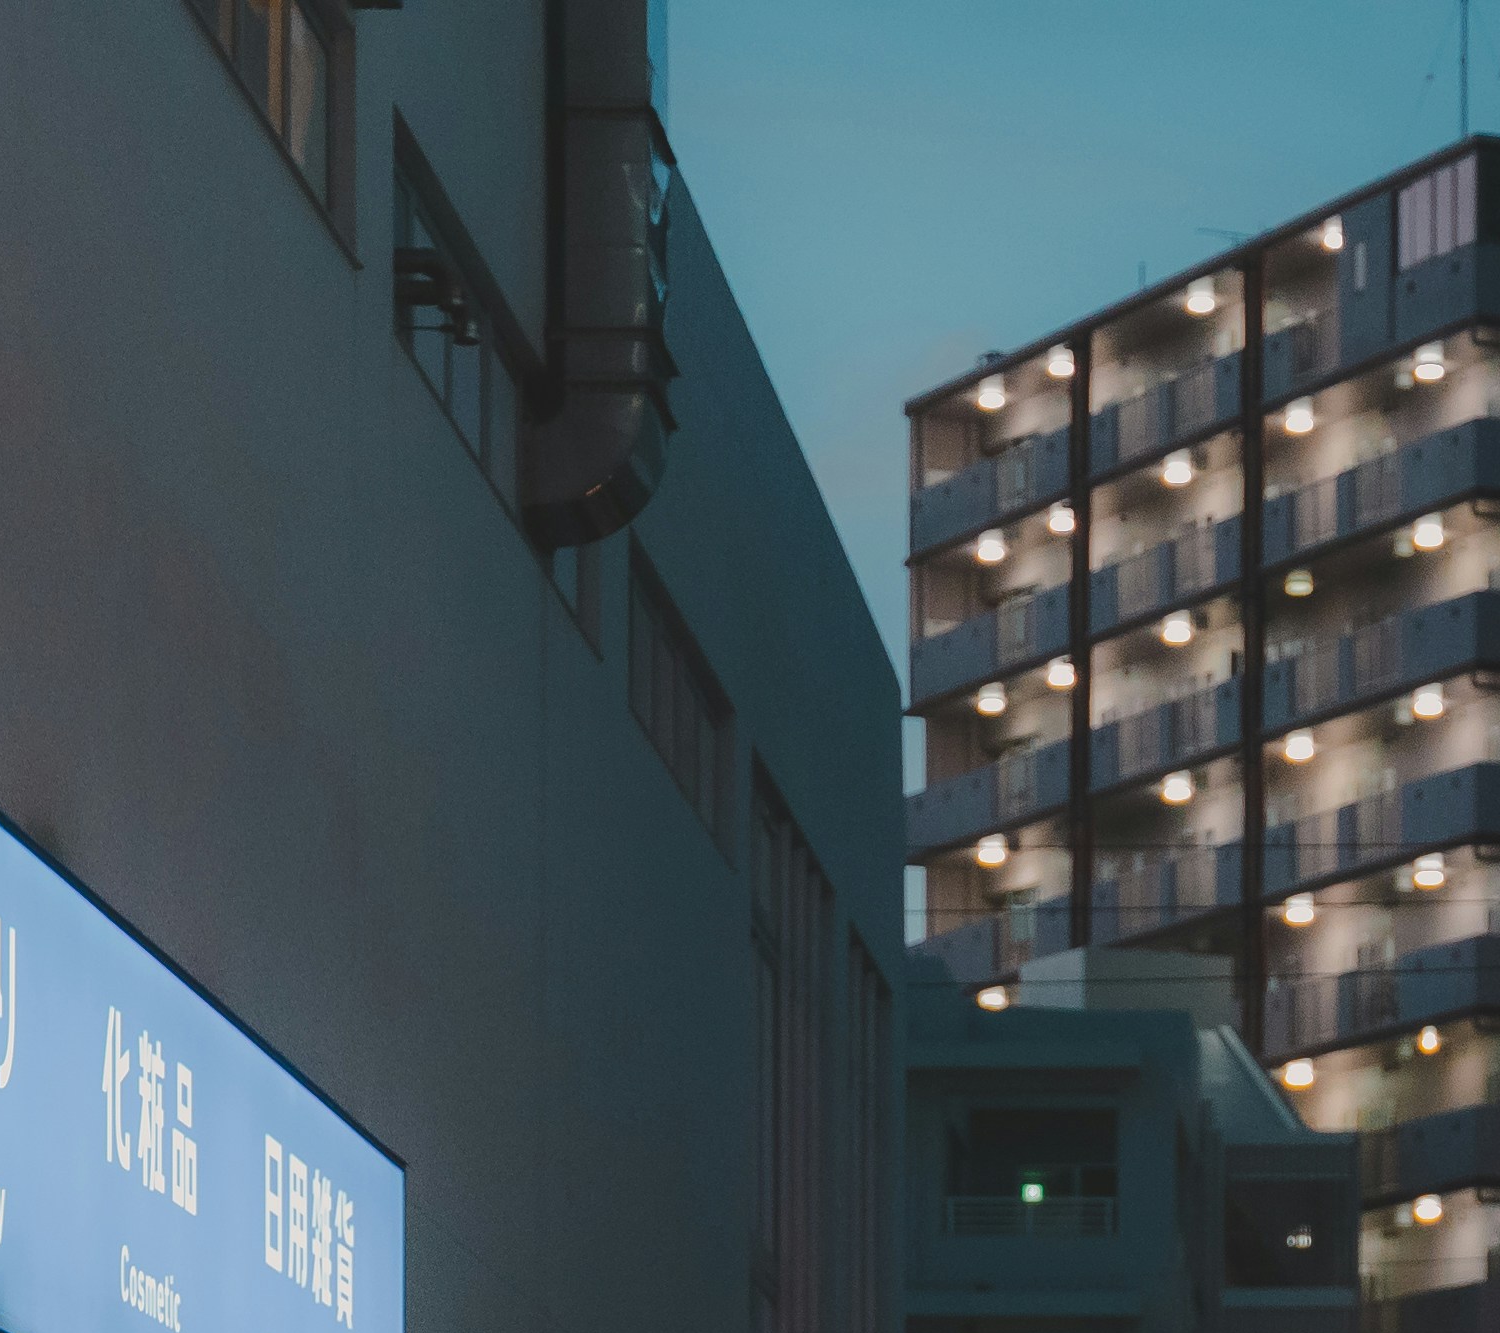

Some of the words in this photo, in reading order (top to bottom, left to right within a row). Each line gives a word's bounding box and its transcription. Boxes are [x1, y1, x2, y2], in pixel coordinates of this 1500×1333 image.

[101, 1004, 198, 1217] 化粧品
[263, 1133, 356, 1331] 日用雑貨
